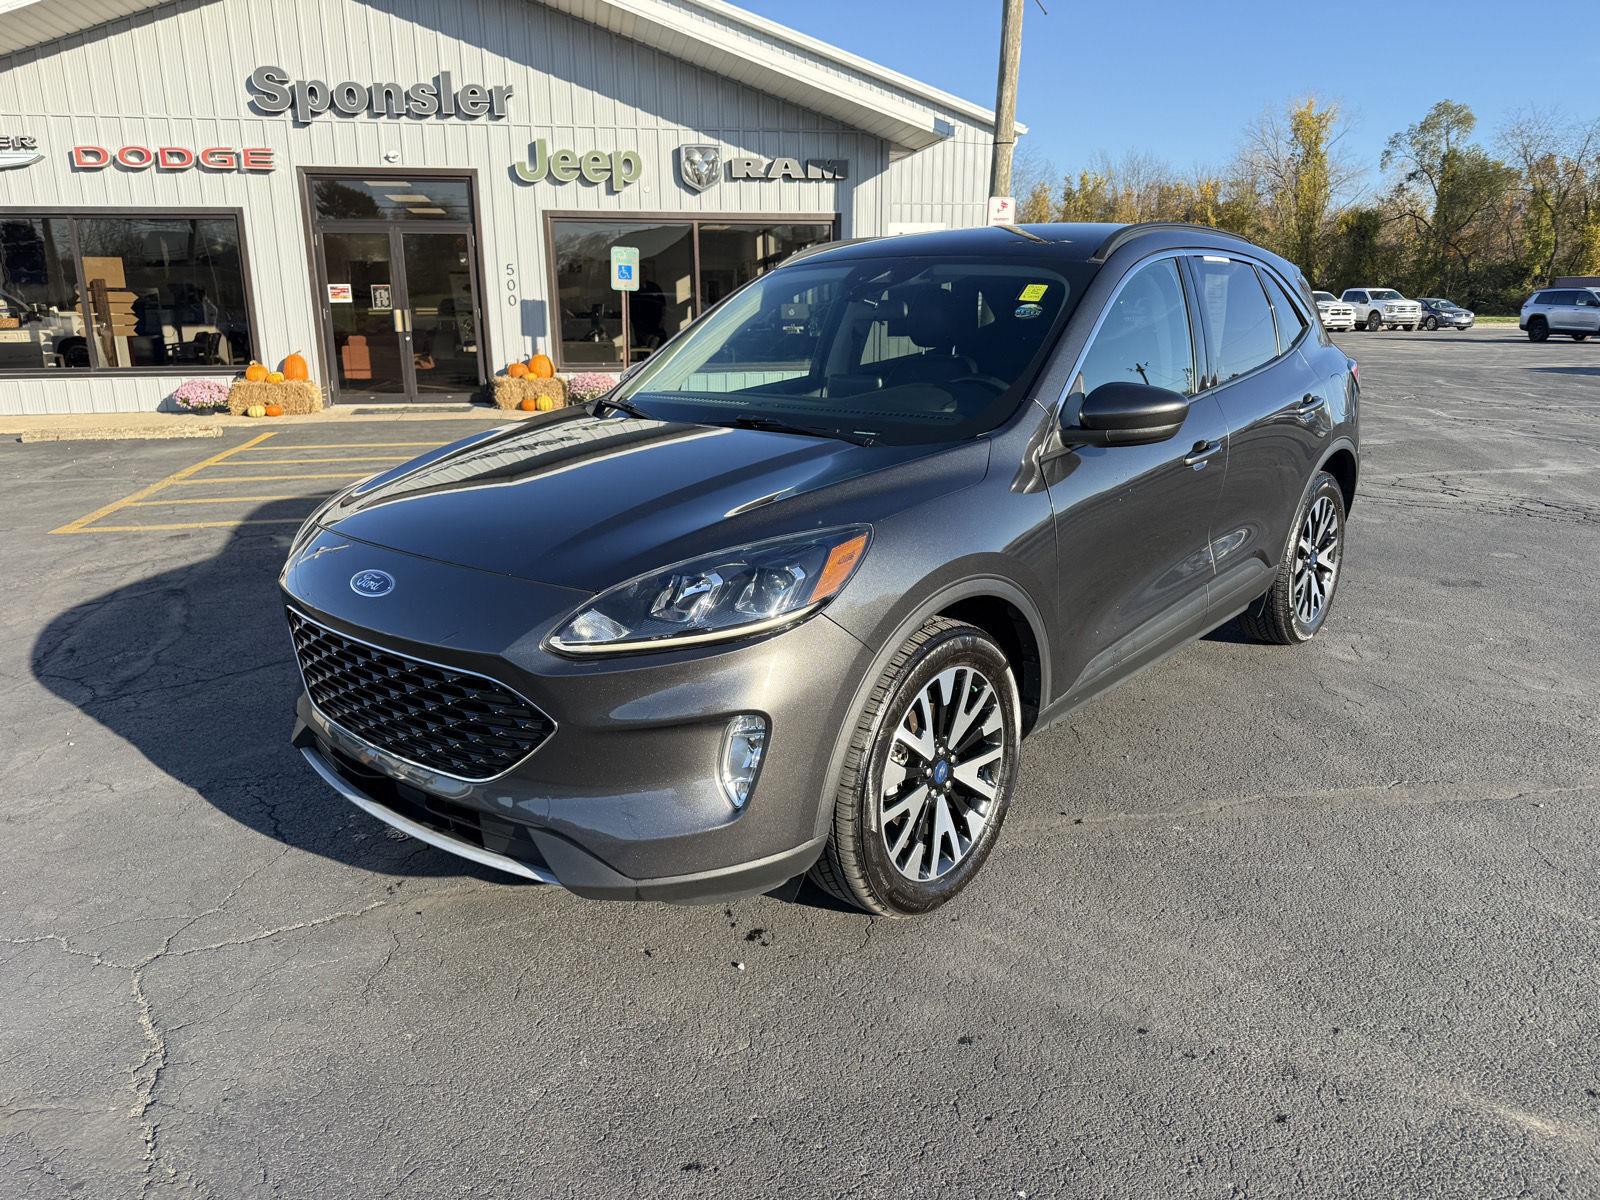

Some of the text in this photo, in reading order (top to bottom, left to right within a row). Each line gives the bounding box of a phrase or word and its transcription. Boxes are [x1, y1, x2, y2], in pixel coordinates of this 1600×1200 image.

[252, 66, 513, 121] Sponsler
[72, 145, 275, 170] DODGE
[515, 139, 642, 191] Jeep
[731, 158, 849, 179] RAM
[506, 263, 517, 306] 500
